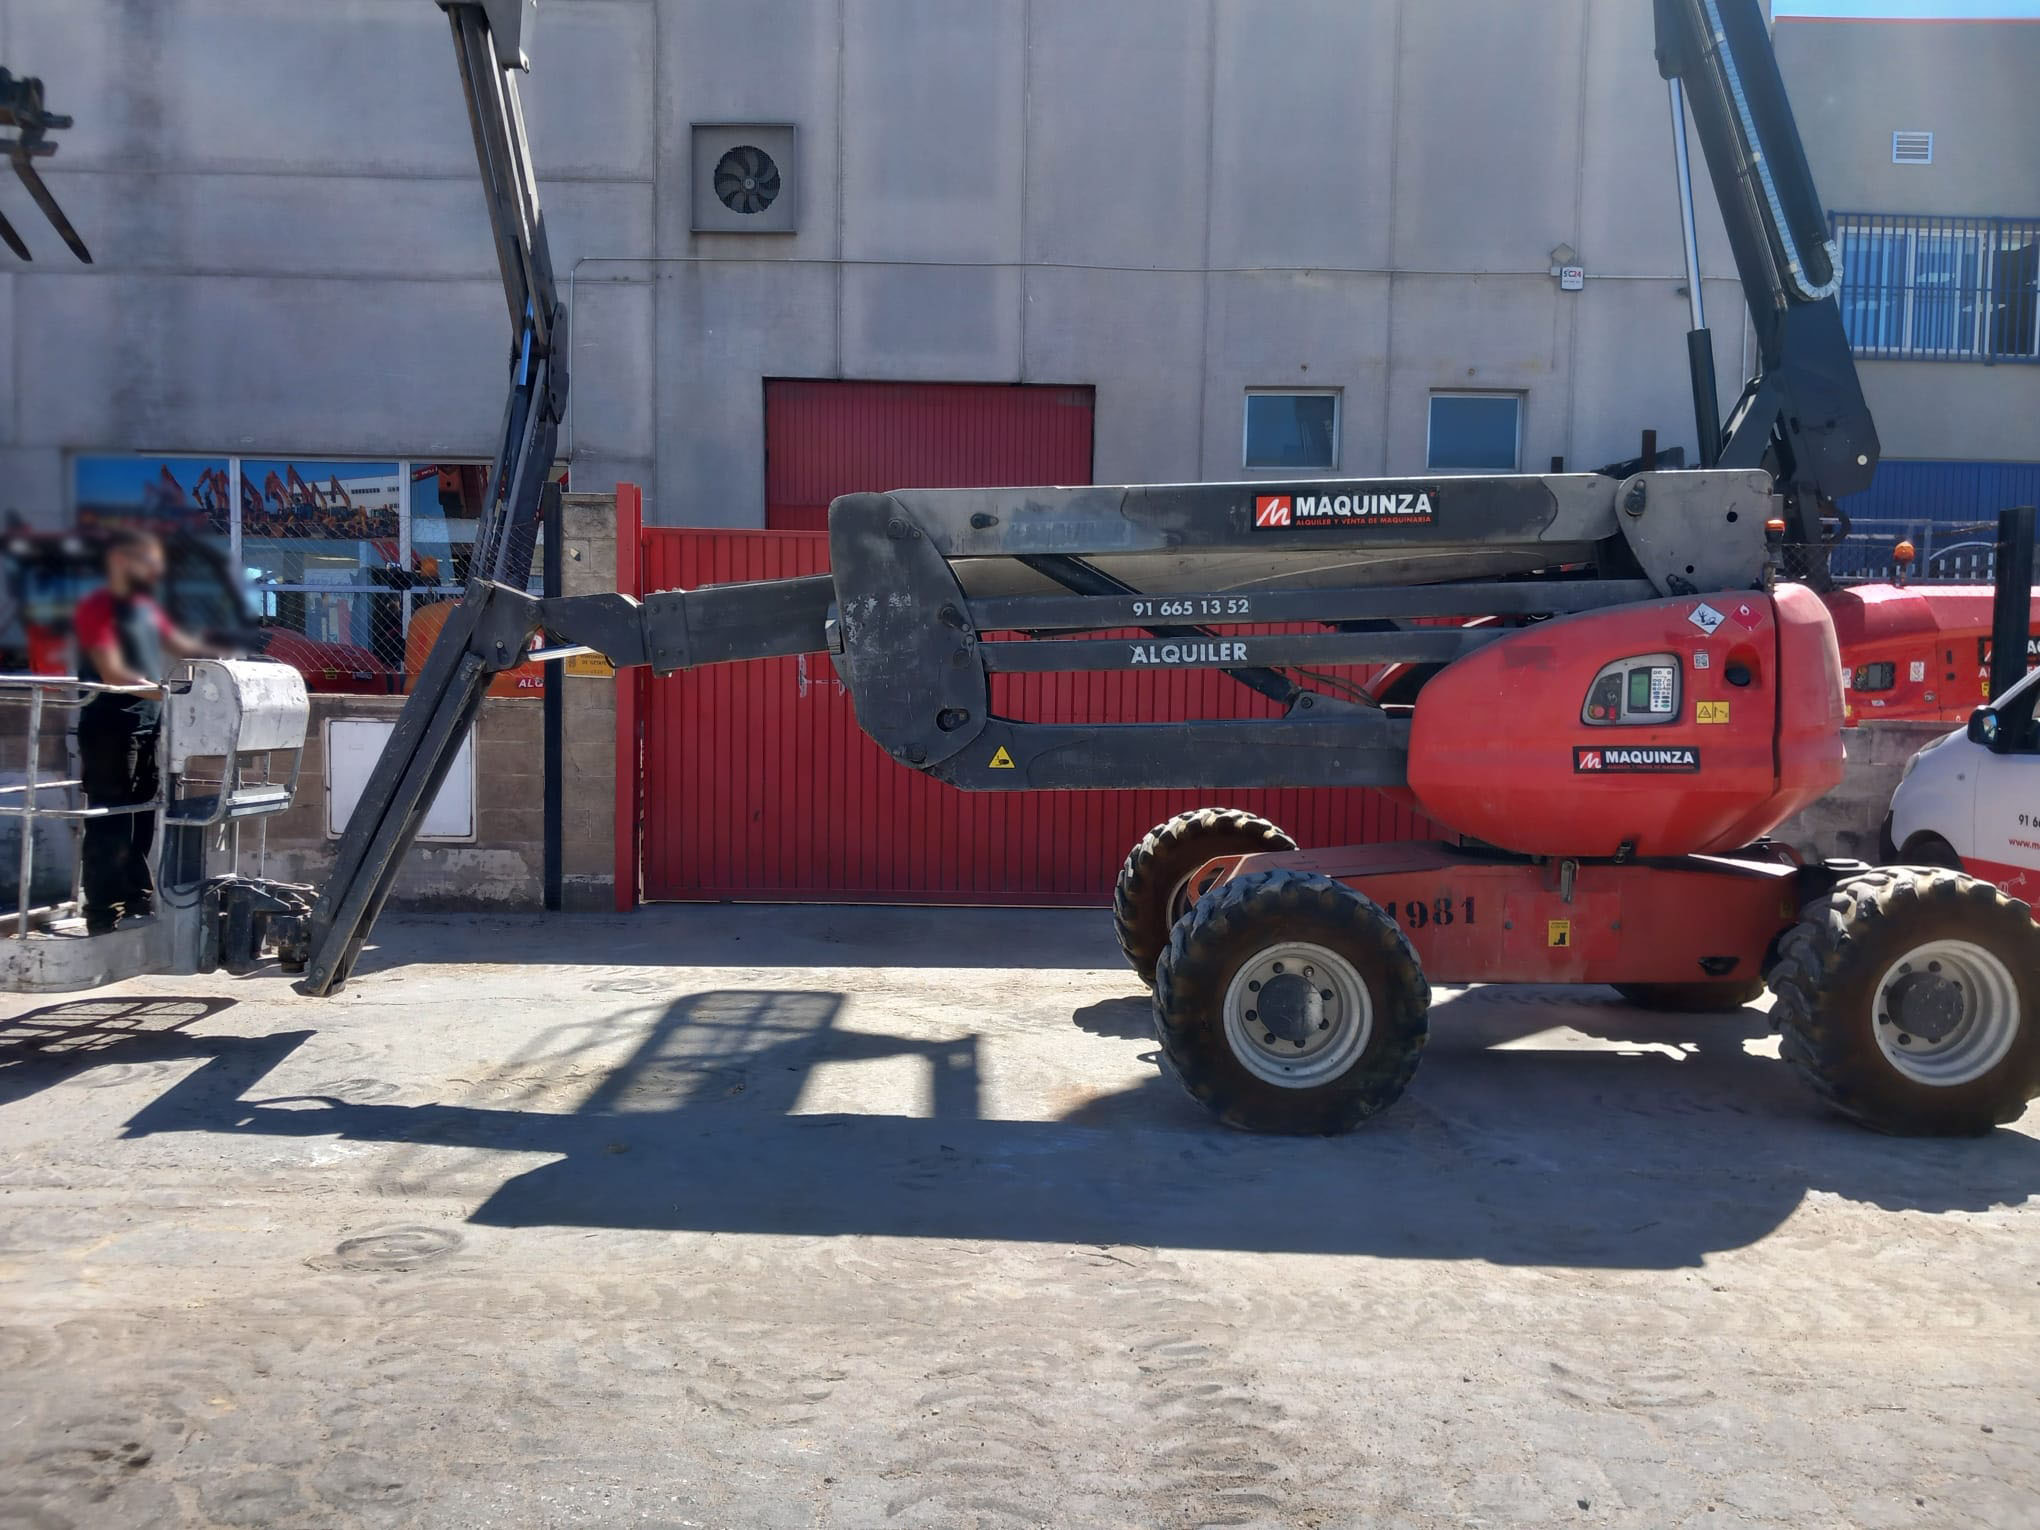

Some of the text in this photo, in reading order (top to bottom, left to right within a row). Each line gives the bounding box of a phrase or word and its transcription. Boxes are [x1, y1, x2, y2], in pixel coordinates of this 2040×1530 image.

[1296, 493, 1432, 517] MAQUINZA
[1380, 516, 1431, 524] MAQUINARIA
[1132, 599, 1249, 616] 91 665 13 52
[1130, 643, 1248, 664] ALQUILER
[1605, 751, 1694, 764] MAQUINZA
[2018, 814, 2040, 828] 91 6
[2008, 839, 2040, 850] www.m
[1384, 897, 1476, 929] 1981
